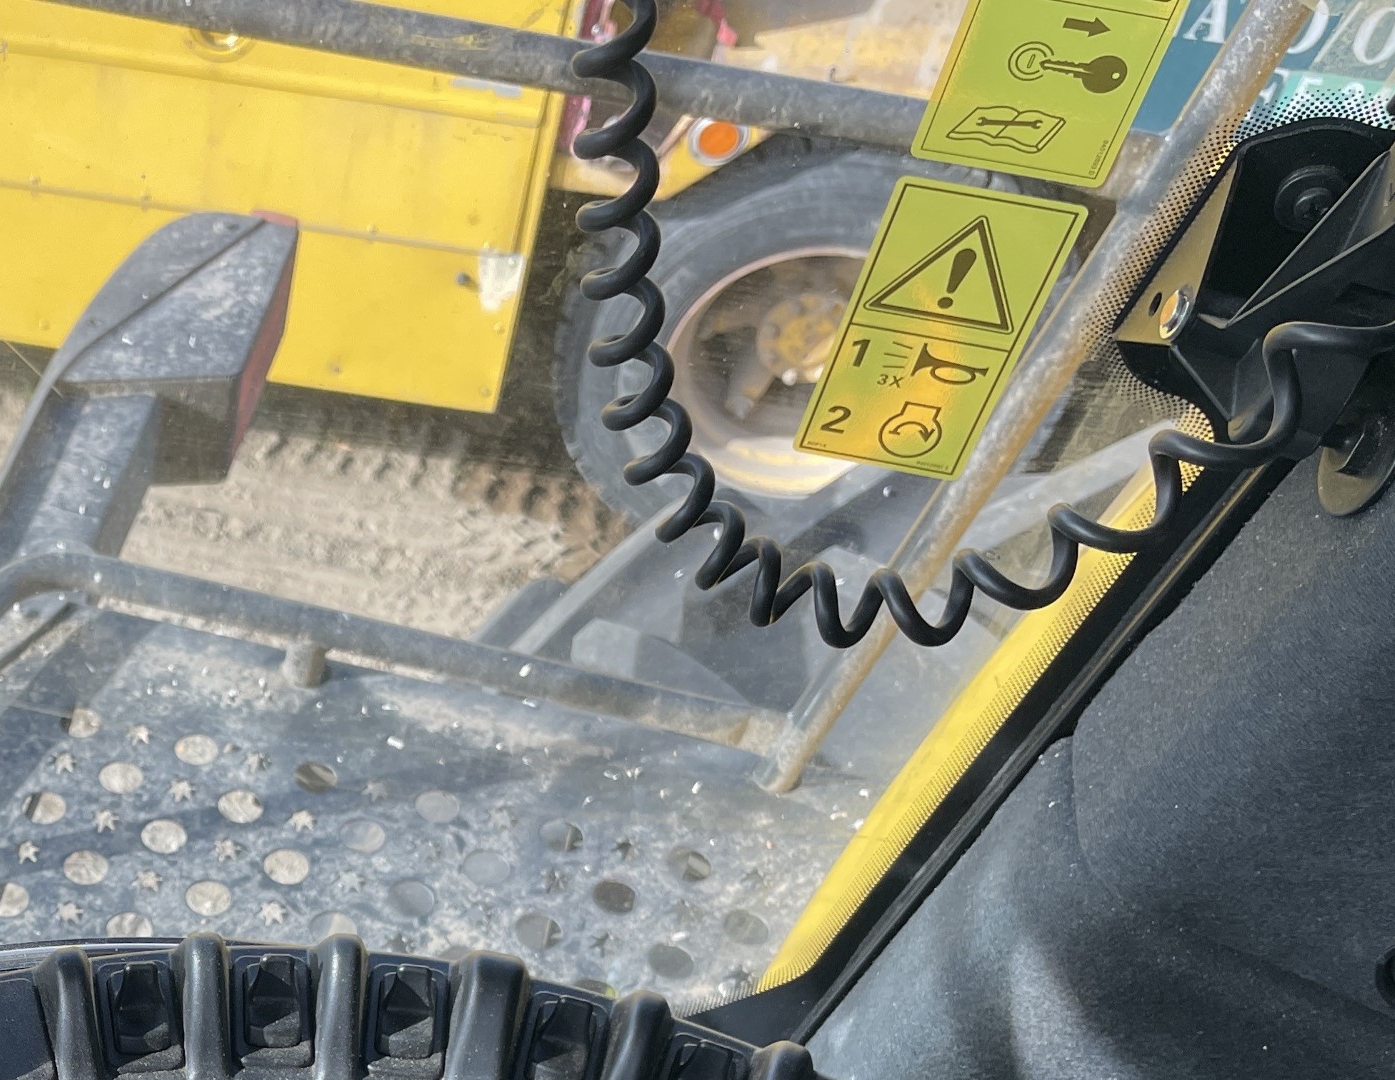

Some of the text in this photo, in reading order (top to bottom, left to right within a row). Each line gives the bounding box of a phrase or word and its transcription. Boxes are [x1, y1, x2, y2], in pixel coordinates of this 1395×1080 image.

[852, 338, 871, 367] 1
[877, 374, 905, 388] 3X
[820, 405, 851, 434] 2
